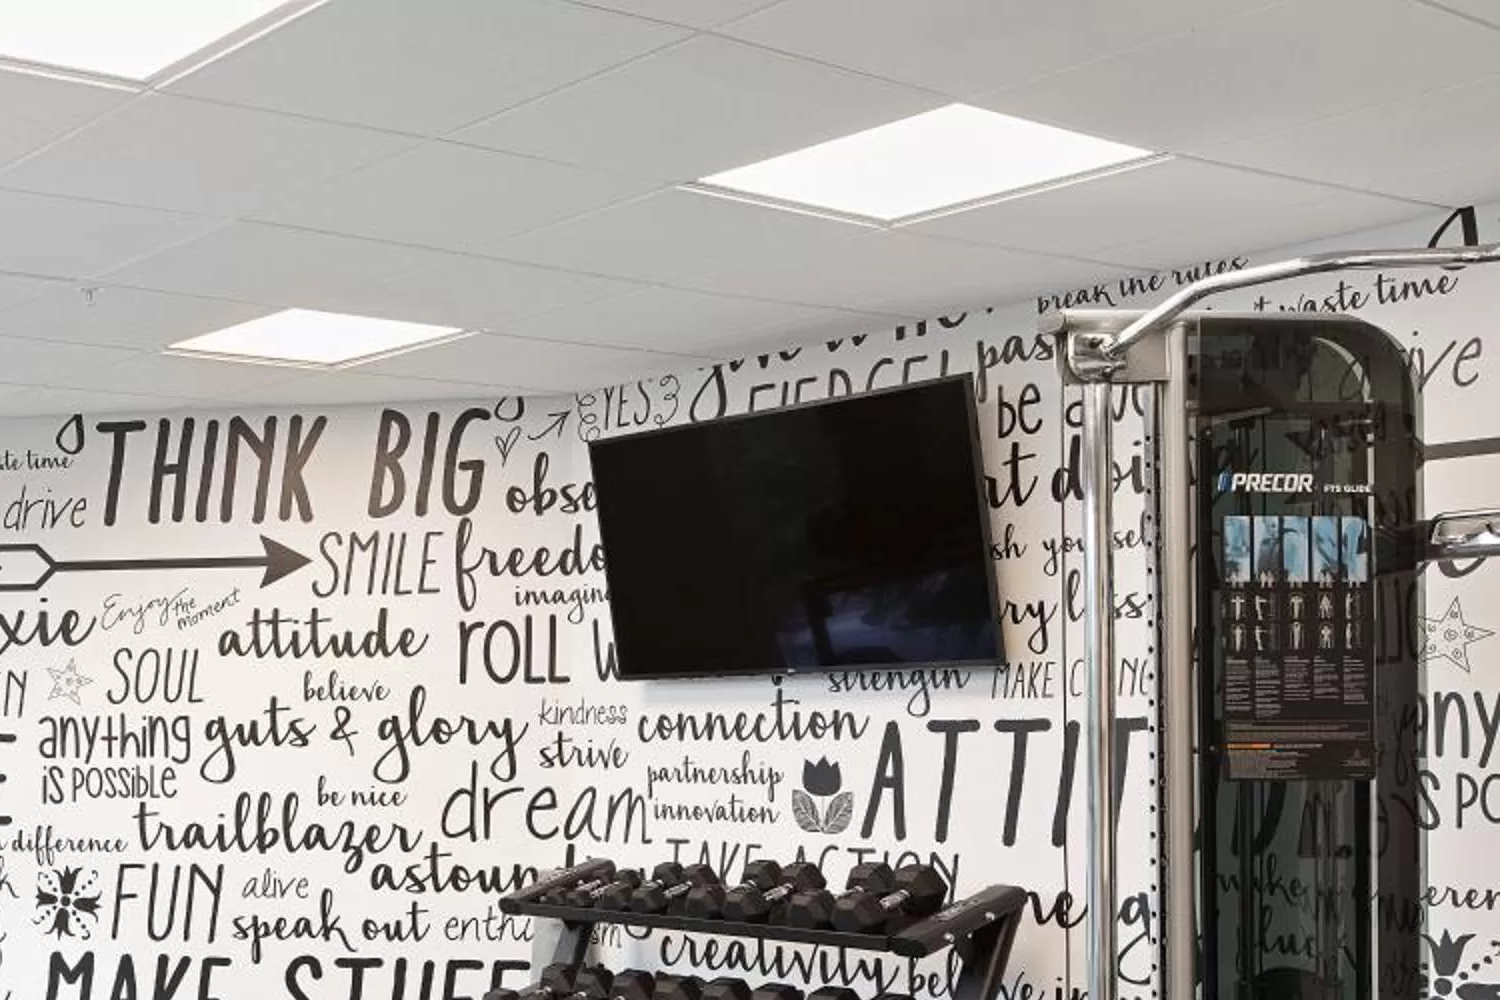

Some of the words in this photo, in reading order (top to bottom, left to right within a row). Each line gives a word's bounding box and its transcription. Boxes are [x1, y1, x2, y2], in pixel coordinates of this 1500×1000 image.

[1374, 272, 1460, 304] time
[603, 378, 651, 432] YES
[997, 382, 1043, 439] be
[26, 449, 74, 471] time
[95, 412, 330, 528] THINK
[365, 405, 492, 521] BIG
[1231, 473, 1313, 493] PRECOR
[2, 482, 88, 533] drive
[312, 530, 444, 597] SMILE
[100, 586, 190, 635] Enjoy
[170, 596, 198, 618] the
[218, 606, 429, 660] attitude
[106, 646, 205, 706] SOUL
[303, 670, 392, 702] believe
[991, 659, 1057, 700] MAKE
[37, 712, 191, 766] anything
[199, 695, 317, 784] guts
[329, 706, 360, 757] &
[372, 684, 530, 783] glory
[537, 697, 629, 727] kindness
[637, 685, 872, 744] connection
[538, 730, 630, 770] strive
[647, 749, 785, 803] partnership
[317, 774, 346, 807] be
[350, 784, 408, 808] nice
[440, 760, 653, 844] dream
[653, 793, 781, 824] innovation
[860, 716, 1150, 848] ATTIT
[11, 824, 130, 868] difference
[132, 792, 424, 874] trailblazer
[110, 862, 225, 943] FUN
[241, 867, 310, 900] alive
[231, 890, 359, 963] speak
[360, 901, 432, 942] out
